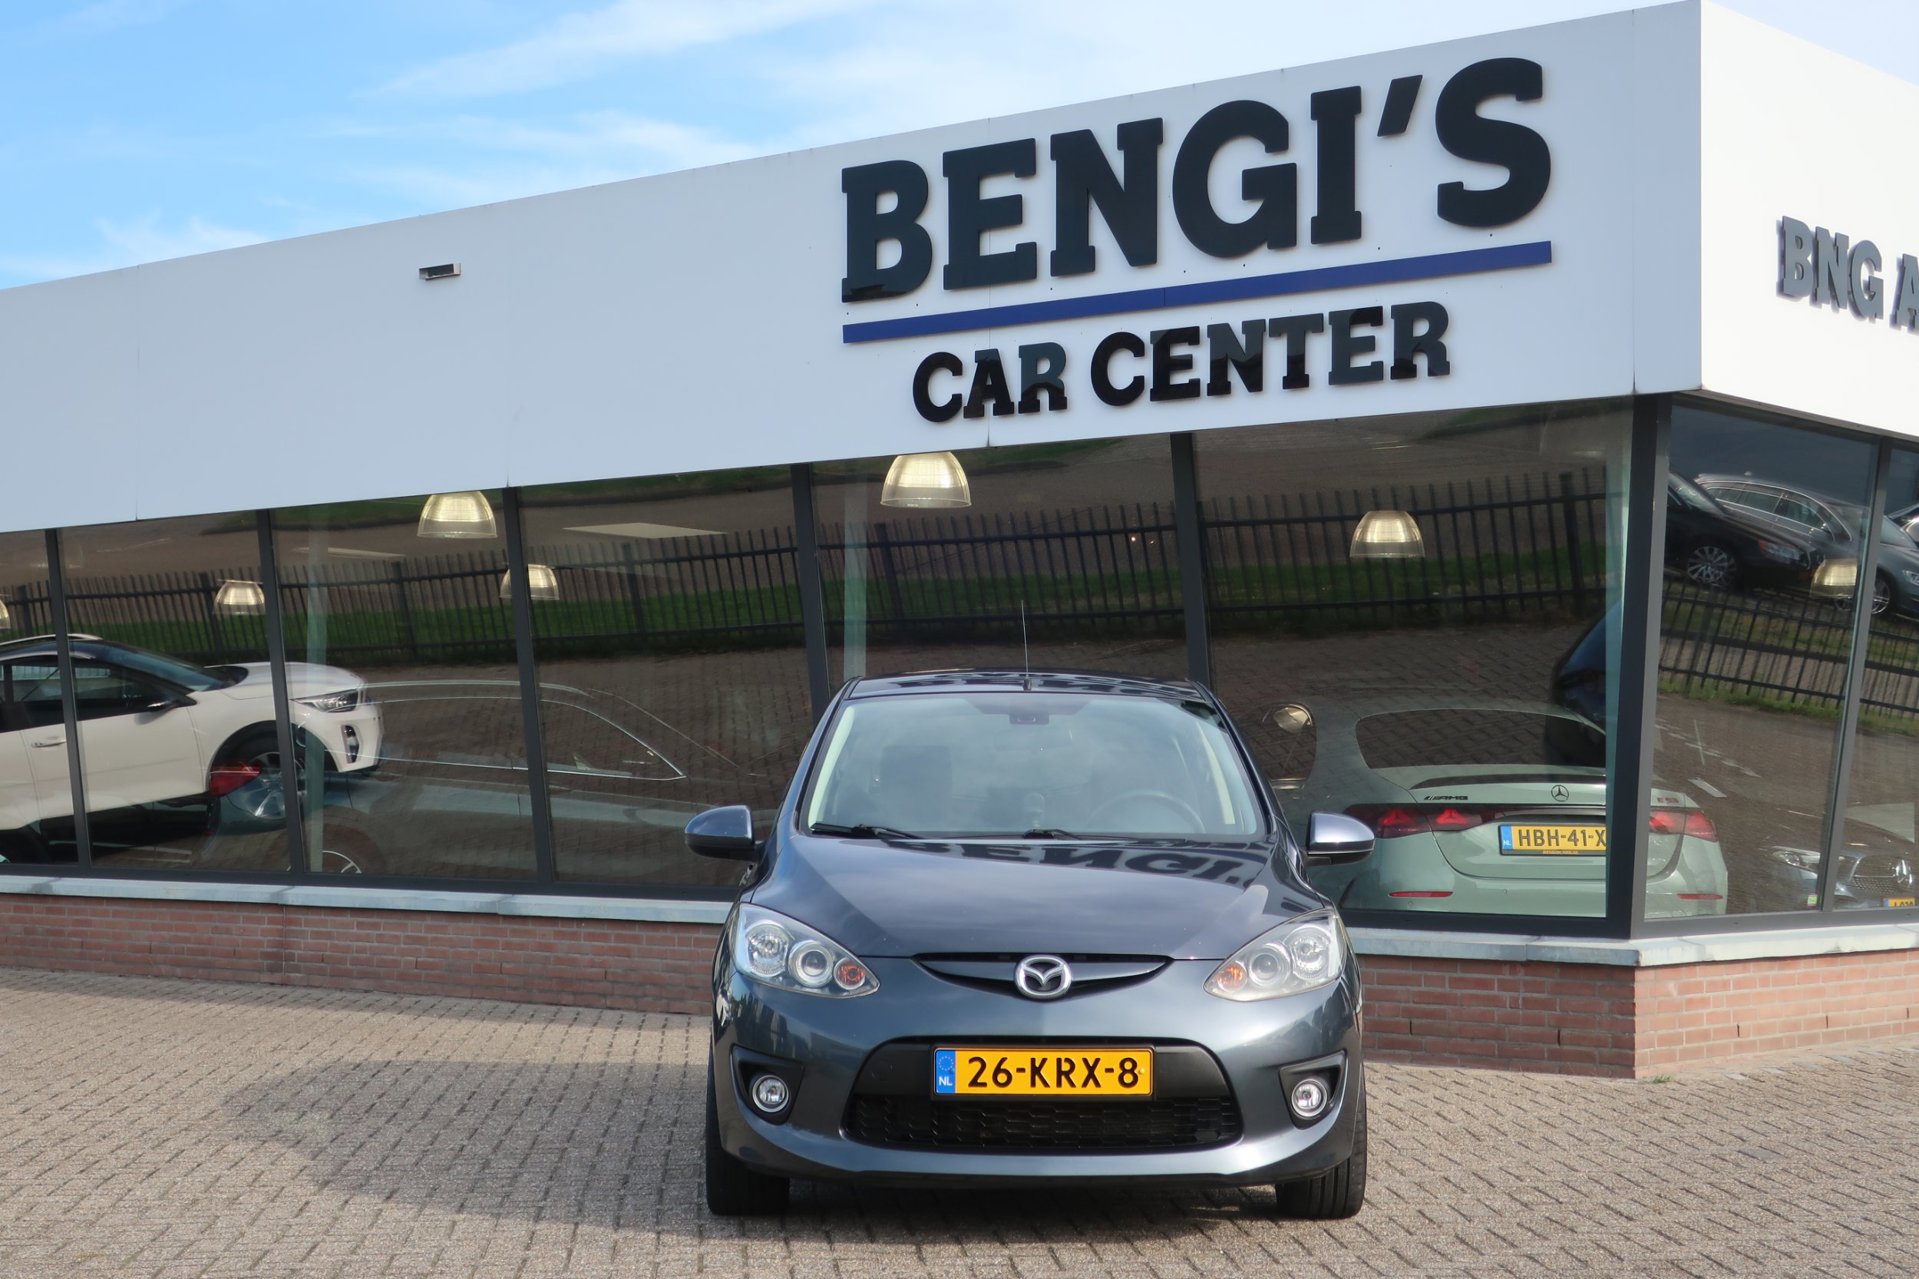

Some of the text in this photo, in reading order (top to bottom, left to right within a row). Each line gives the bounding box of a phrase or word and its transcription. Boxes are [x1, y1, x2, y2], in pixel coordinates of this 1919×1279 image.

[842, 58, 1551, 303] BENGI'S
[1778, 216, 1884, 322] BNG
[913, 302, 1450, 423] CAR CENTER
[1518, 829, 1606, 847] HBH-41-X
[938, 1056, 1139, 1089] NL 26-KRX-8
